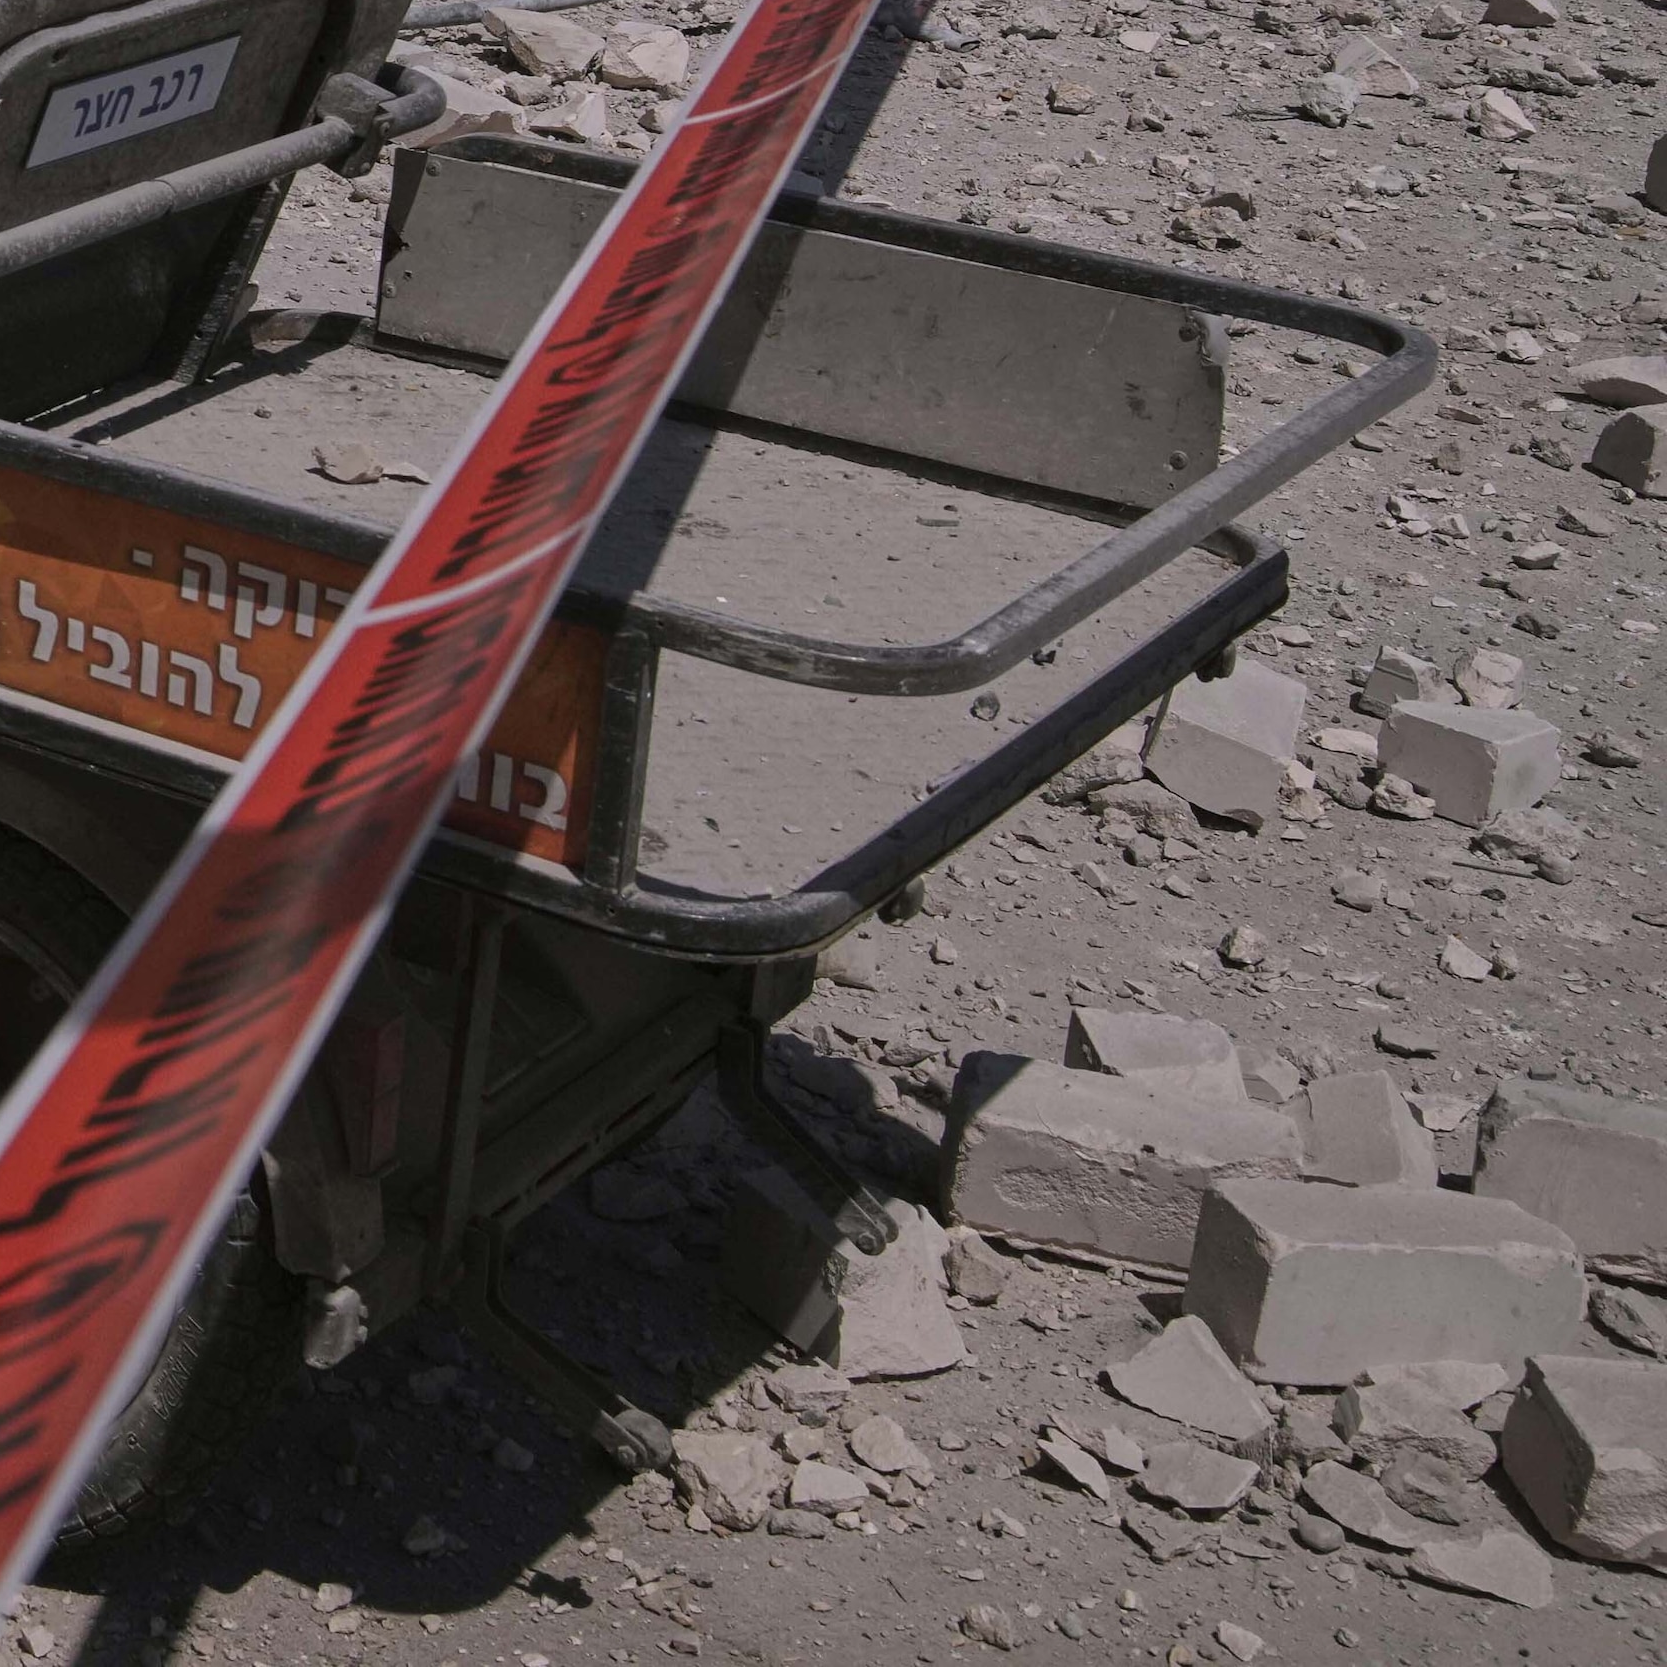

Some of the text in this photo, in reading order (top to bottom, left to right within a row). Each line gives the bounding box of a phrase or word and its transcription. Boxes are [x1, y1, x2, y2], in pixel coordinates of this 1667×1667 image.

[73, 64, 204, 139] רכב חצר
[18, 579, 263, 730] להוביל
